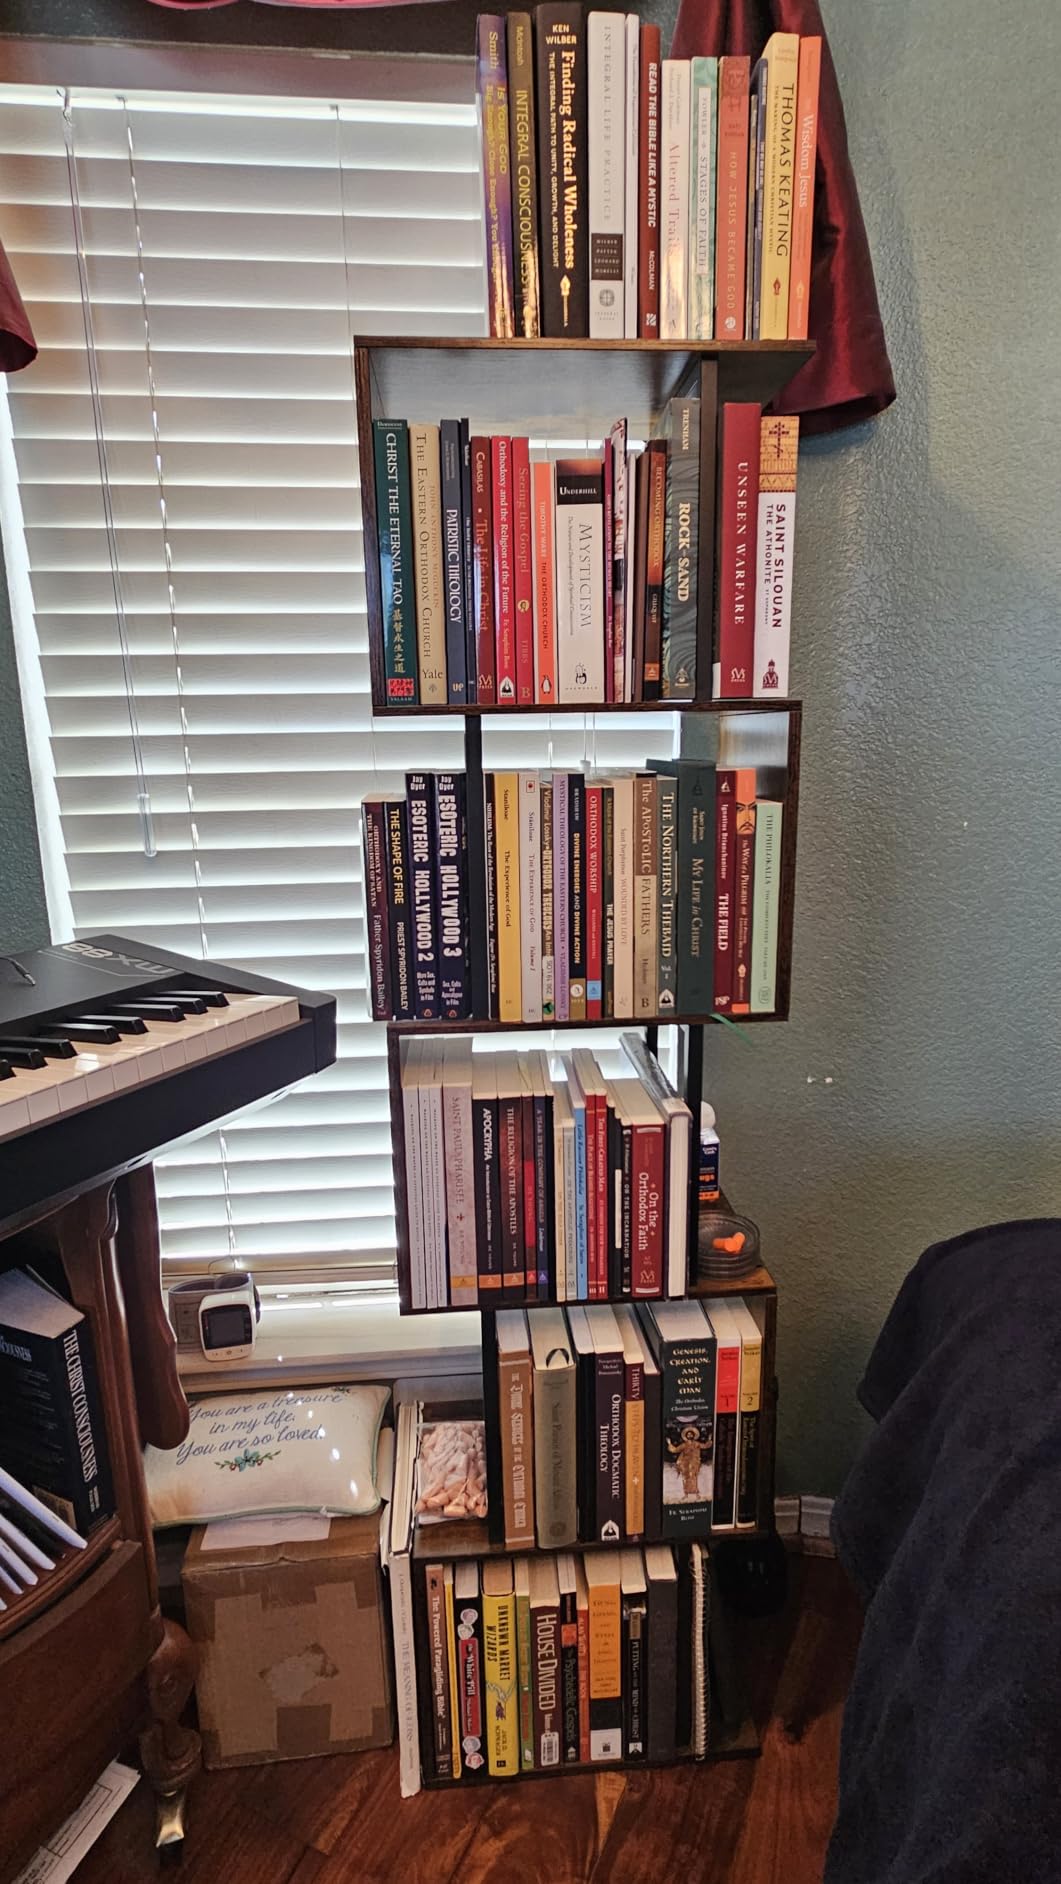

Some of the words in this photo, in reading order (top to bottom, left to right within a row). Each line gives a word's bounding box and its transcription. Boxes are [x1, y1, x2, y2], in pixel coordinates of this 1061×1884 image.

[546, 36, 577, 45] WILBER
[552, 24, 570, 33] KEN
[489, 32, 498, 69] Smith
[559, 51, 576, 116] Finding
[648, 62, 658, 94] READ
[649, 96, 657, 117] THE
[515, 90, 529, 161] INTEGRAL
[648, 119, 657, 150] BIBLE
[779, 83, 795, 167] THOMAS
[800, 114, 814, 171] Wisdom
[562, 120, 577, 182] Radical
[648, 152, 657, 176] LIKE
[729, 151, 737, 180] HOW
[648, 176, 657, 186] A
[700, 156, 708, 206] STAGES
[798, 174, 811, 208] Jesus
[648, 187, 656, 228] MYSTIC
[700, 208, 708, 226] OF
[728, 184, 737, 224] JESUS
[776, 175, 791, 257] KEATING
[517, 165, 532, 284] CONSCIOUSNESS
[563, 185, 577, 269] Wholeness
[699, 229, 707, 267] FAITH
[728, 231, 736, 280] BECAME
[728, 287, 736, 310] GOD
[416, 433, 427, 462] THE
[682, 408, 690, 451] TRENHAM
[386, 433, 398, 483] CHRIST
[476, 452, 486, 493] CABASILAS
[497, 440, 508, 488] Orthodoxy
[388, 488, 399, 511] THE
[416, 468, 429, 525] EASTERN
[500, 489, 508, 506] and
[517, 467, 529, 512] Seeing
[736, 462, 749, 535] UNSEEN
[500, 508, 509, 522] the
[520, 514, 530, 531] the
[678, 502, 692, 550] ROCK
[766, 504, 774, 528] THE
[774, 504, 786, 553] SAINT
[390, 517, 402, 575] ETERNAL
[446, 510, 460, 562] PATRISTIC
[499, 524, 510, 558] Religion
[419, 530, 431, 602] ORTHODOX
[502, 560, 511, 569] of
[518, 539, 530, 573] Gospel
[764, 530, 772, 584] ATHONITE
[392, 580, 403, 605] TAO
[448, 563, 462, 623] THEOLOGY
[502, 570, 511, 585] the
[578, 523, 593, 627] MYSTICISM
[677, 558, 690, 602] SAND
[734, 543, 747, 625] WARFARE
[502, 586, 511, 614] Future
[772, 559, 785, 629] SILOUAN
[422, 607, 433, 658] CHURCH
[422, 669, 443, 679] Yale
[390, 809, 400, 830] THE
[590, 796, 598, 850] ORTHODOX
[662, 792, 674, 821] THE
[410, 800, 428, 863] ESOTERIC
[439, 794, 458, 857] ESOTERIC
[543, 822, 551, 846] Lossky
[392, 832, 402, 865] SHAPE
[560, 856, 567, 866] OF
[573, 832, 581, 858] DIVINE
[662, 825, 674, 896] NORTHERN
[393, 866, 402, 881] OF
[573, 860, 581, 893] ENERGIES
[692, 858, 704, 877] MY
[394, 882, 404, 905] FIRE
[441, 865, 460, 944] HOLLYWOOD
[640, 878, 651, 936] FATHERS
[692, 880, 704, 902] LIFE
[718, 893, 729, 918] THE
[414, 870, 432, 949] HOLLYWOOD
[693, 906, 703, 916] in
[374, 914, 383, 943] Father
[396, 922, 406, 947] PRIEST
[662, 900, 674, 957] THEBAID
[691, 917, 703, 957] CHRIST
[718, 920, 729, 951] FIELD
[374, 944, 384, 983] Spyridon
[398, 947, 407, 985] SPYRIDON
[418, 952, 434, 961] 2
[443, 948, 463, 957] 3
[376, 984, 386, 1009] Bailey
[400, 986, 409, 1011] BAILEY
[452, 1096, 461, 1126] SAINT
[506, 1107, 514, 1124] THE
[454, 1128, 462, 1148] PAUL
[483, 1108, 493, 1161] APOCRYPHA
[507, 1126, 515, 1165] RELIGION
[455, 1156, 465, 1204] PHARISEE
[508, 1166, 515, 1176] OF
[624, 1184, 630, 1194] ON
[638, 1172, 649, 1222] Orthodox
[648, 1192, 659, 1207] On
[509, 1197, 517, 1235] APOSTLES
[648, 1212, 659, 1227] the
[638, 1225, 649, 1251] Faith
[62, 1330, 79, 1356] THE
[66, 1354, 86, 1398] CHRIST
[632, 1367, 640, 1400] THIRTY
[224, 1404, 252, 1418] are
[256, 1401, 271, 1413] a
[270, 1393, 345, 1411] treasure
[611, 1394, 621, 1448] ORTHODOX
[72, 1391, 98, 1484] CONSCIOUSNESS
[209, 1421, 232, 1435] in
[230, 1418, 262, 1434] my
[176, 1443, 220, 1466] You
[218, 1440, 249, 1454] are
[251, 1434, 273, 1448] so
[276, 1424, 323, 1443] loved.
[599, 1423, 610, 1473] THEOLOGY
[611, 1450, 621, 1499] DOGMATIC
[431, 1596, 440, 1612] The
[432, 1613, 442, 1648] Powered
[486, 1624, 497, 1663] WIZARDS
[498, 1605, 509, 1646] UNKNOWN
[536, 1614, 557, 1659] HOUSE
[433, 1649, 444, 1696] Paragliding
[500, 1649, 511, 1681] MARKET
[632, 1641, 640, 1672] PUTTING
[538, 1658, 558, 1711] DIVIDED
[563, 1658, 578, 1706] Psychedelic
[566, 1708, 577, 1742] Gospels
